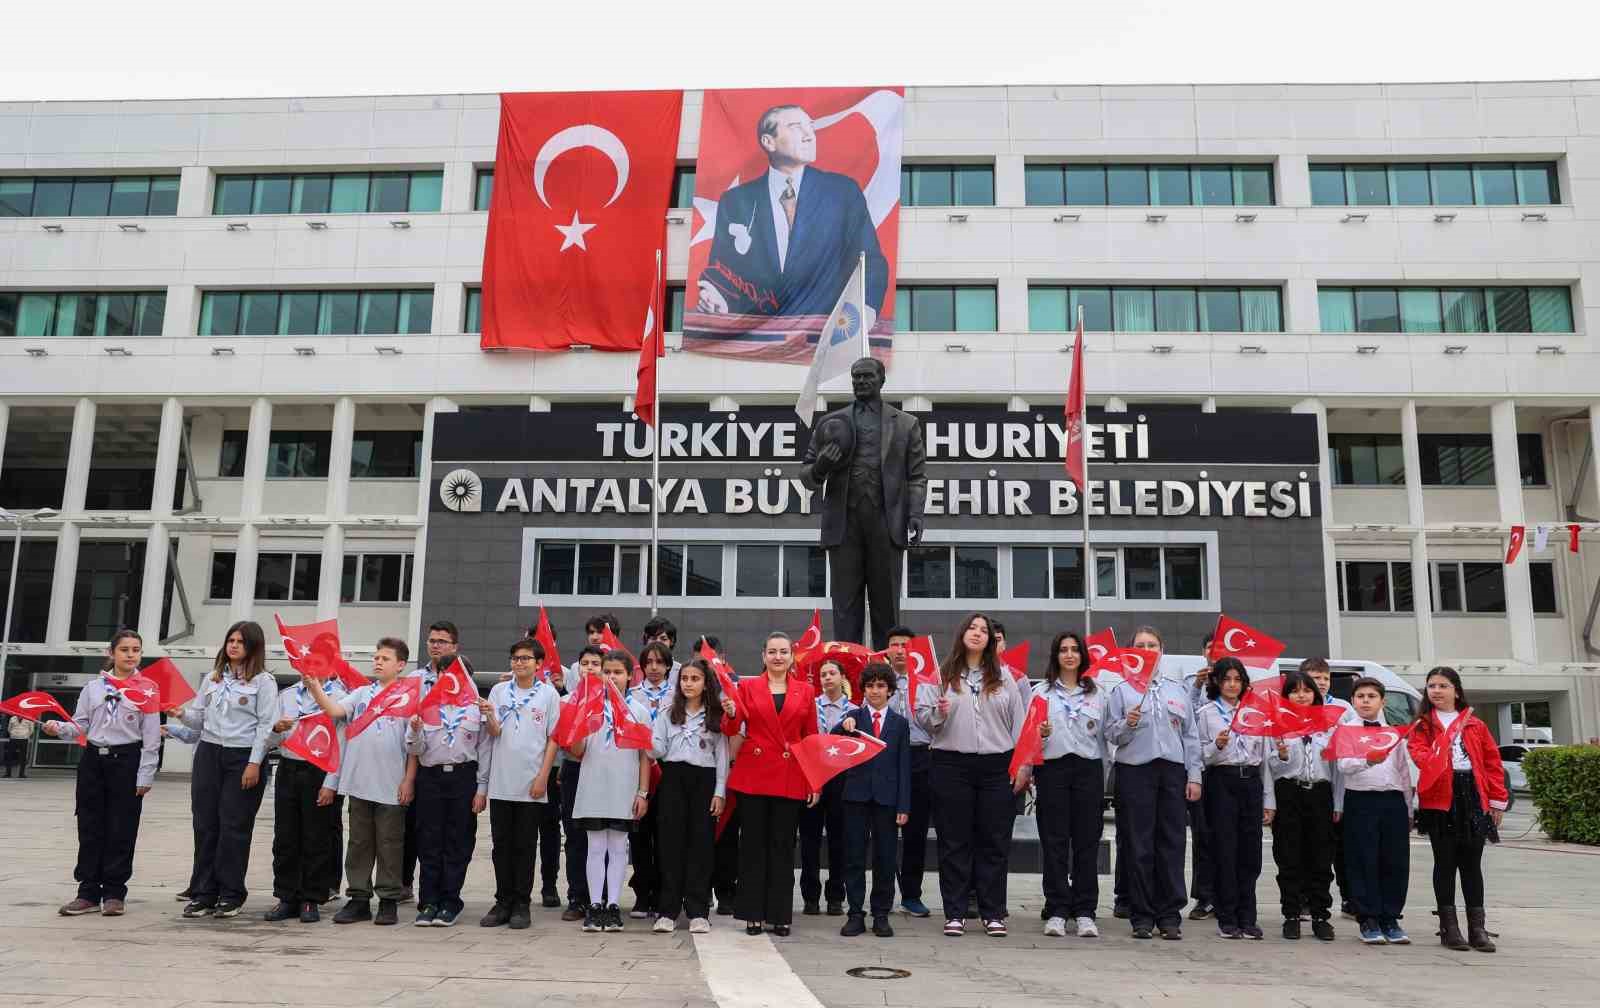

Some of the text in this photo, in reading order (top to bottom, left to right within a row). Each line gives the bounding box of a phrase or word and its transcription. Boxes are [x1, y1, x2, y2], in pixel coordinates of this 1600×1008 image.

[597, 412, 1150, 459] TÜRKİYE HURİYETİ
[496, 467, 1312, 517] ANTALYA BÜYEHİR BELEDİYESİ
